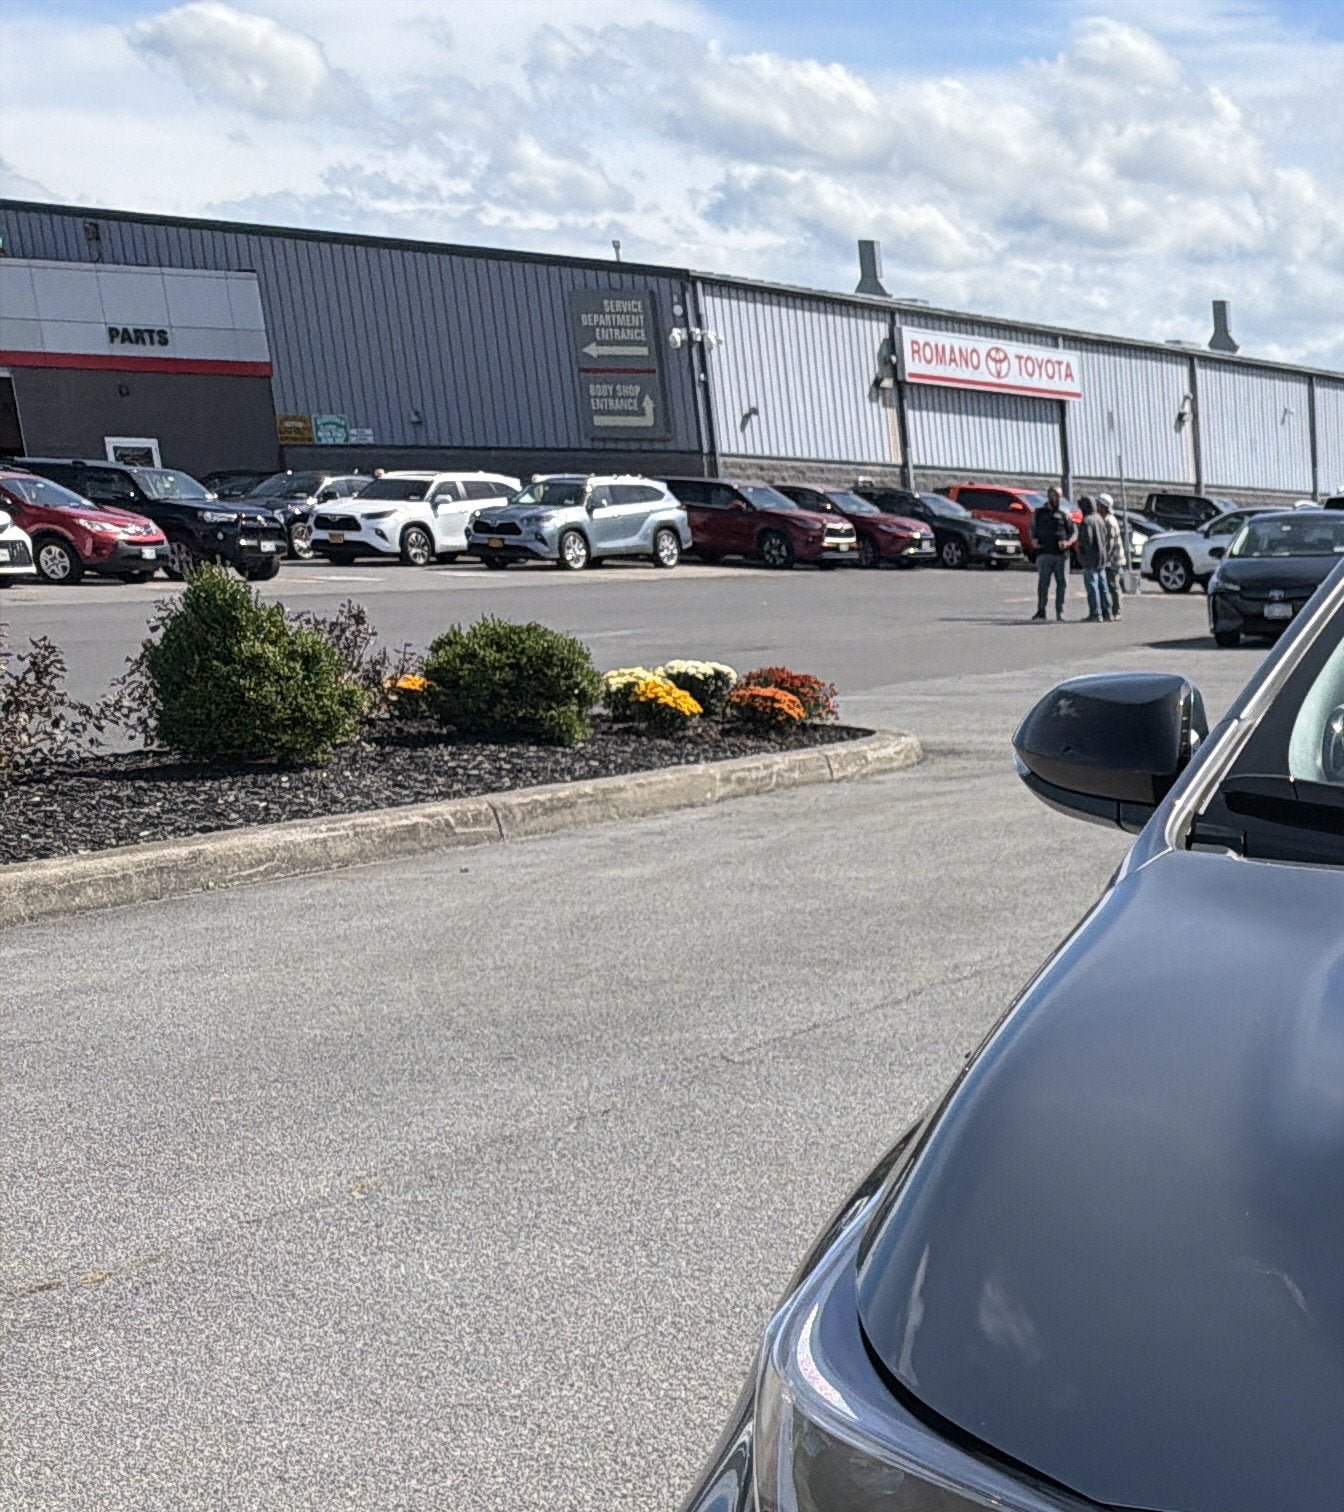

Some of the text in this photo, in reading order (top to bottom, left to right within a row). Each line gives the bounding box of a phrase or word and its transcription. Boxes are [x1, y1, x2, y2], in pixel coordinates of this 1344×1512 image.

[603, 300, 642, 312] SERVICE
[581, 314, 643, 326] DEPARTMENT
[108, 327, 168, 346] PARTS
[595, 328, 646, 340] ENTRANCE
[911, 340, 1074, 382] ROMANO TOYOTA
[589, 385, 640, 396] BODY SHOP
[590, 398, 638, 410] ENTRANCE
